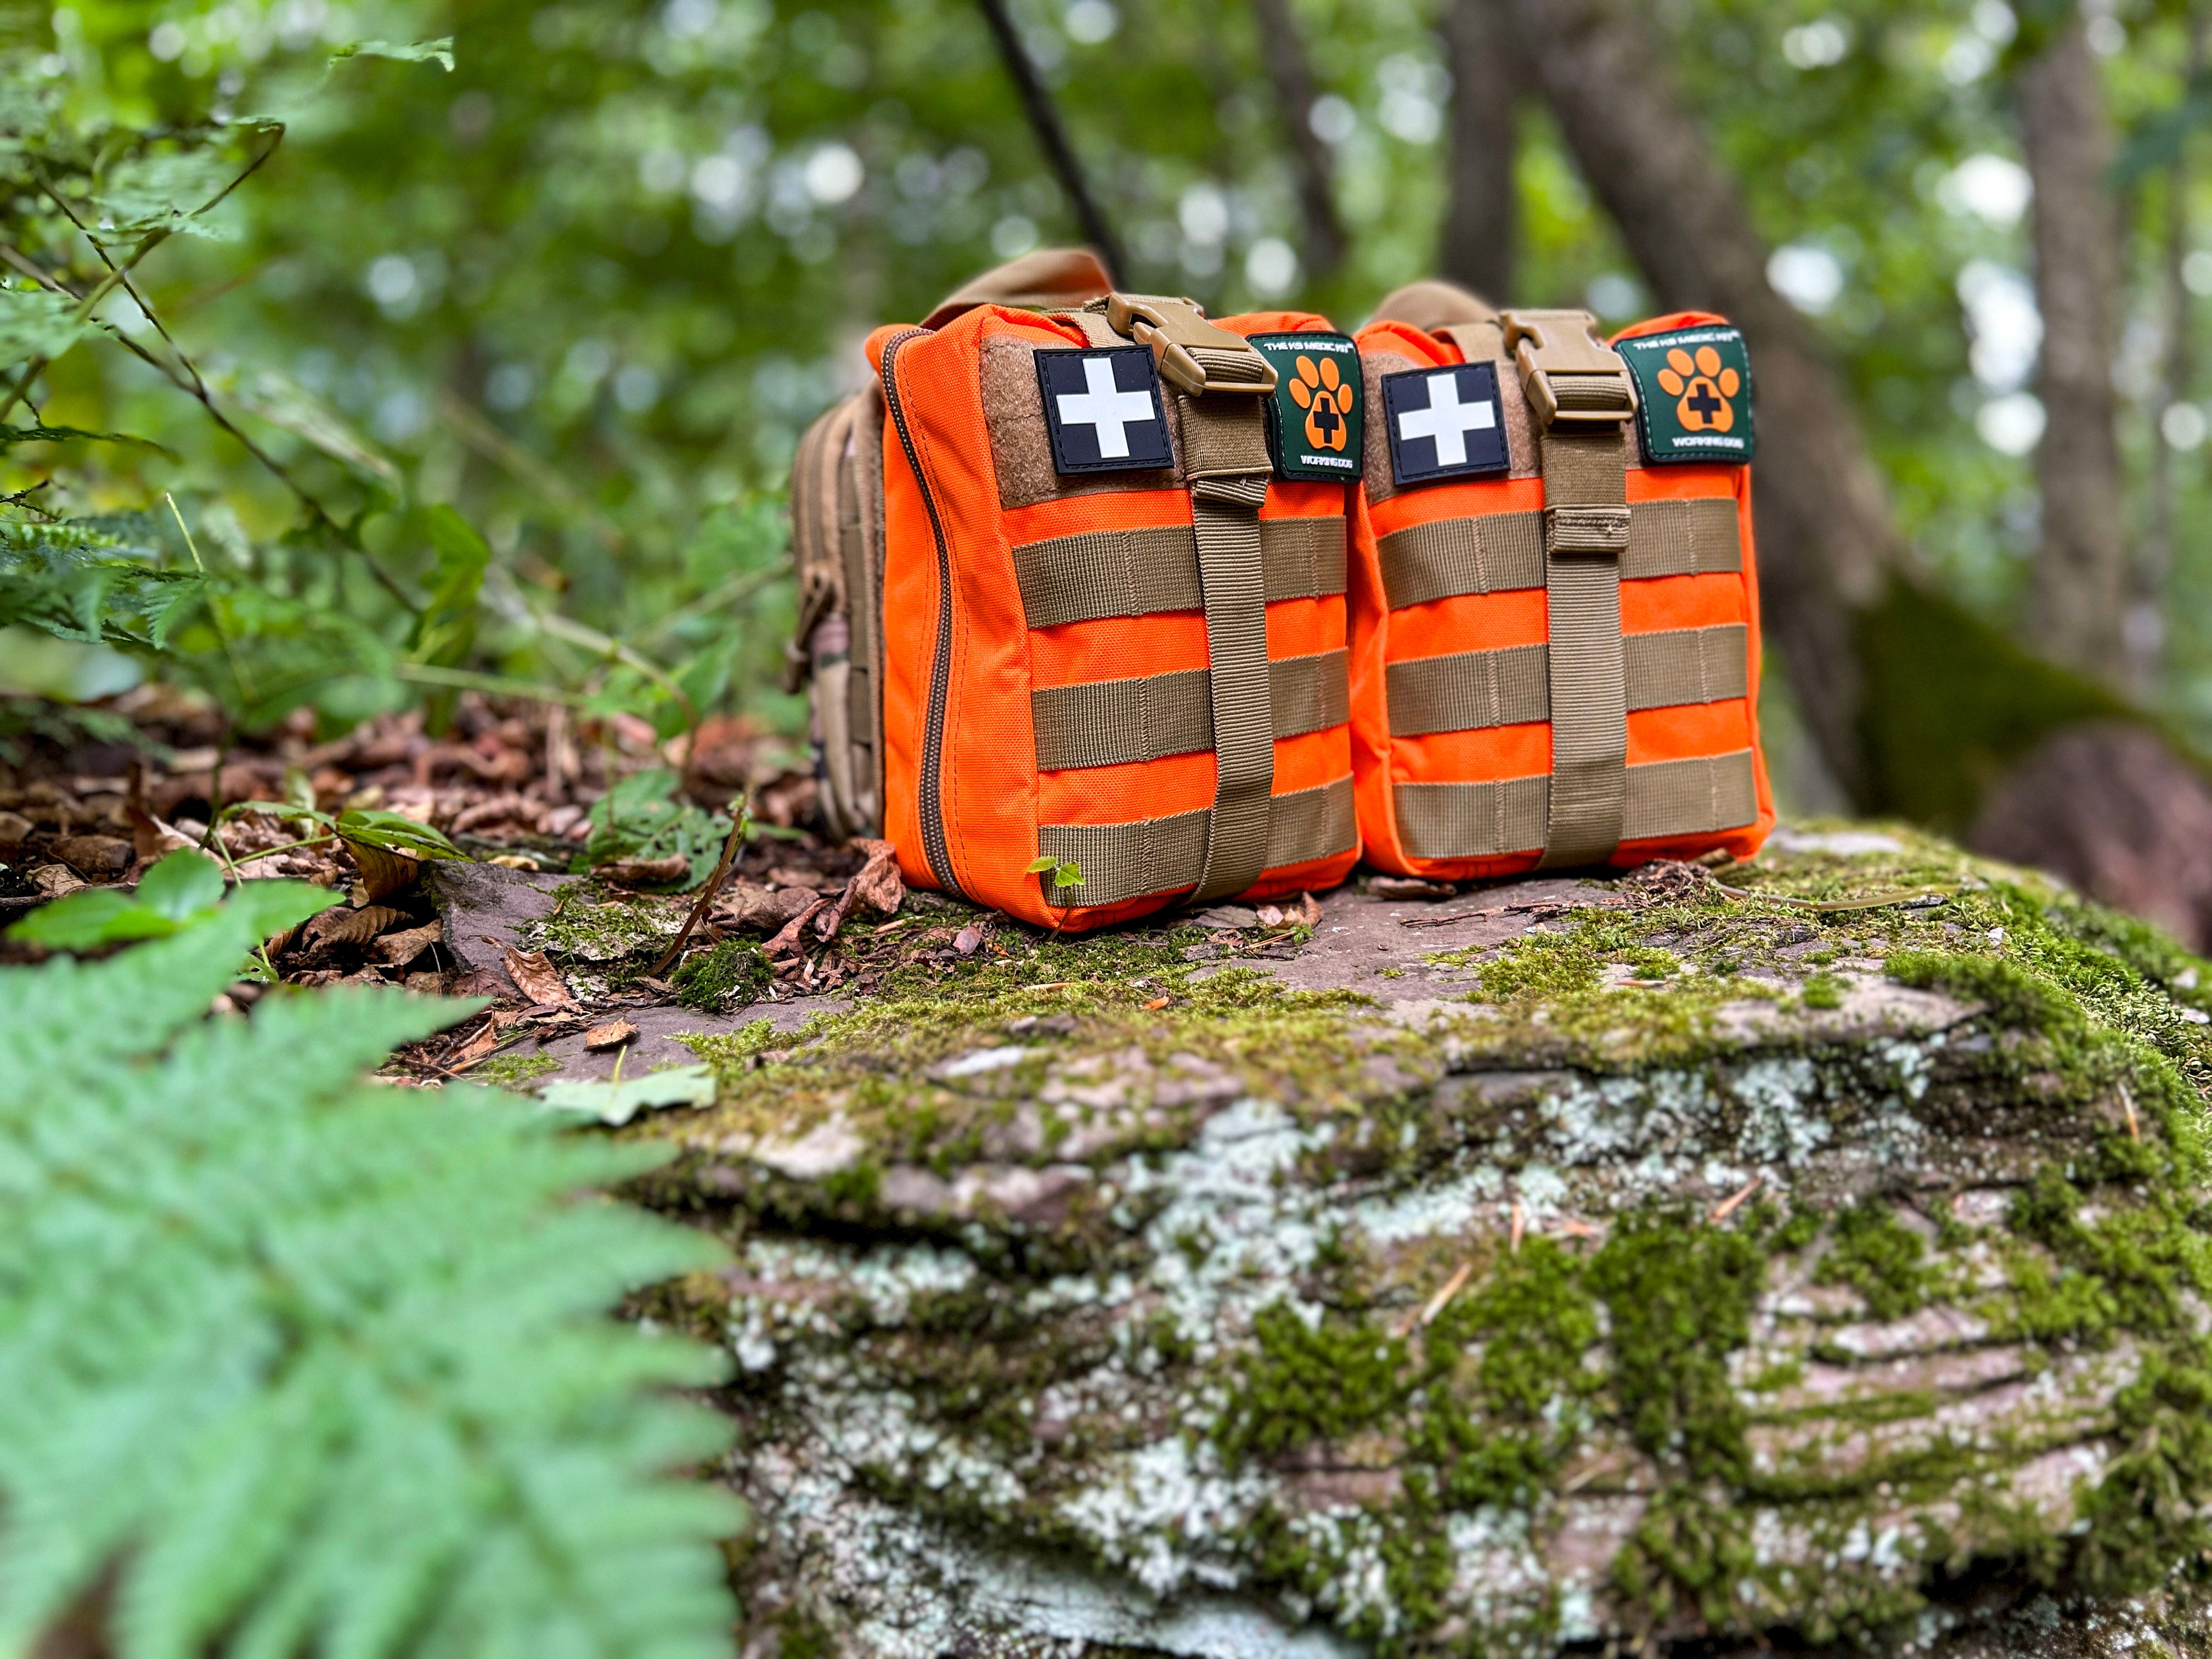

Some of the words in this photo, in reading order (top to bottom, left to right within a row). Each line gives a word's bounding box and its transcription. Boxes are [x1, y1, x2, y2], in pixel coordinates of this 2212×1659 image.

[1264, 342, 1288, 351] THE
[1304, 342, 1335, 352] MEDIC
[1634, 340, 1659, 349] THE
[1673, 437, 1723, 447] WORKING
[1300, 455, 1338, 466] WORKING
